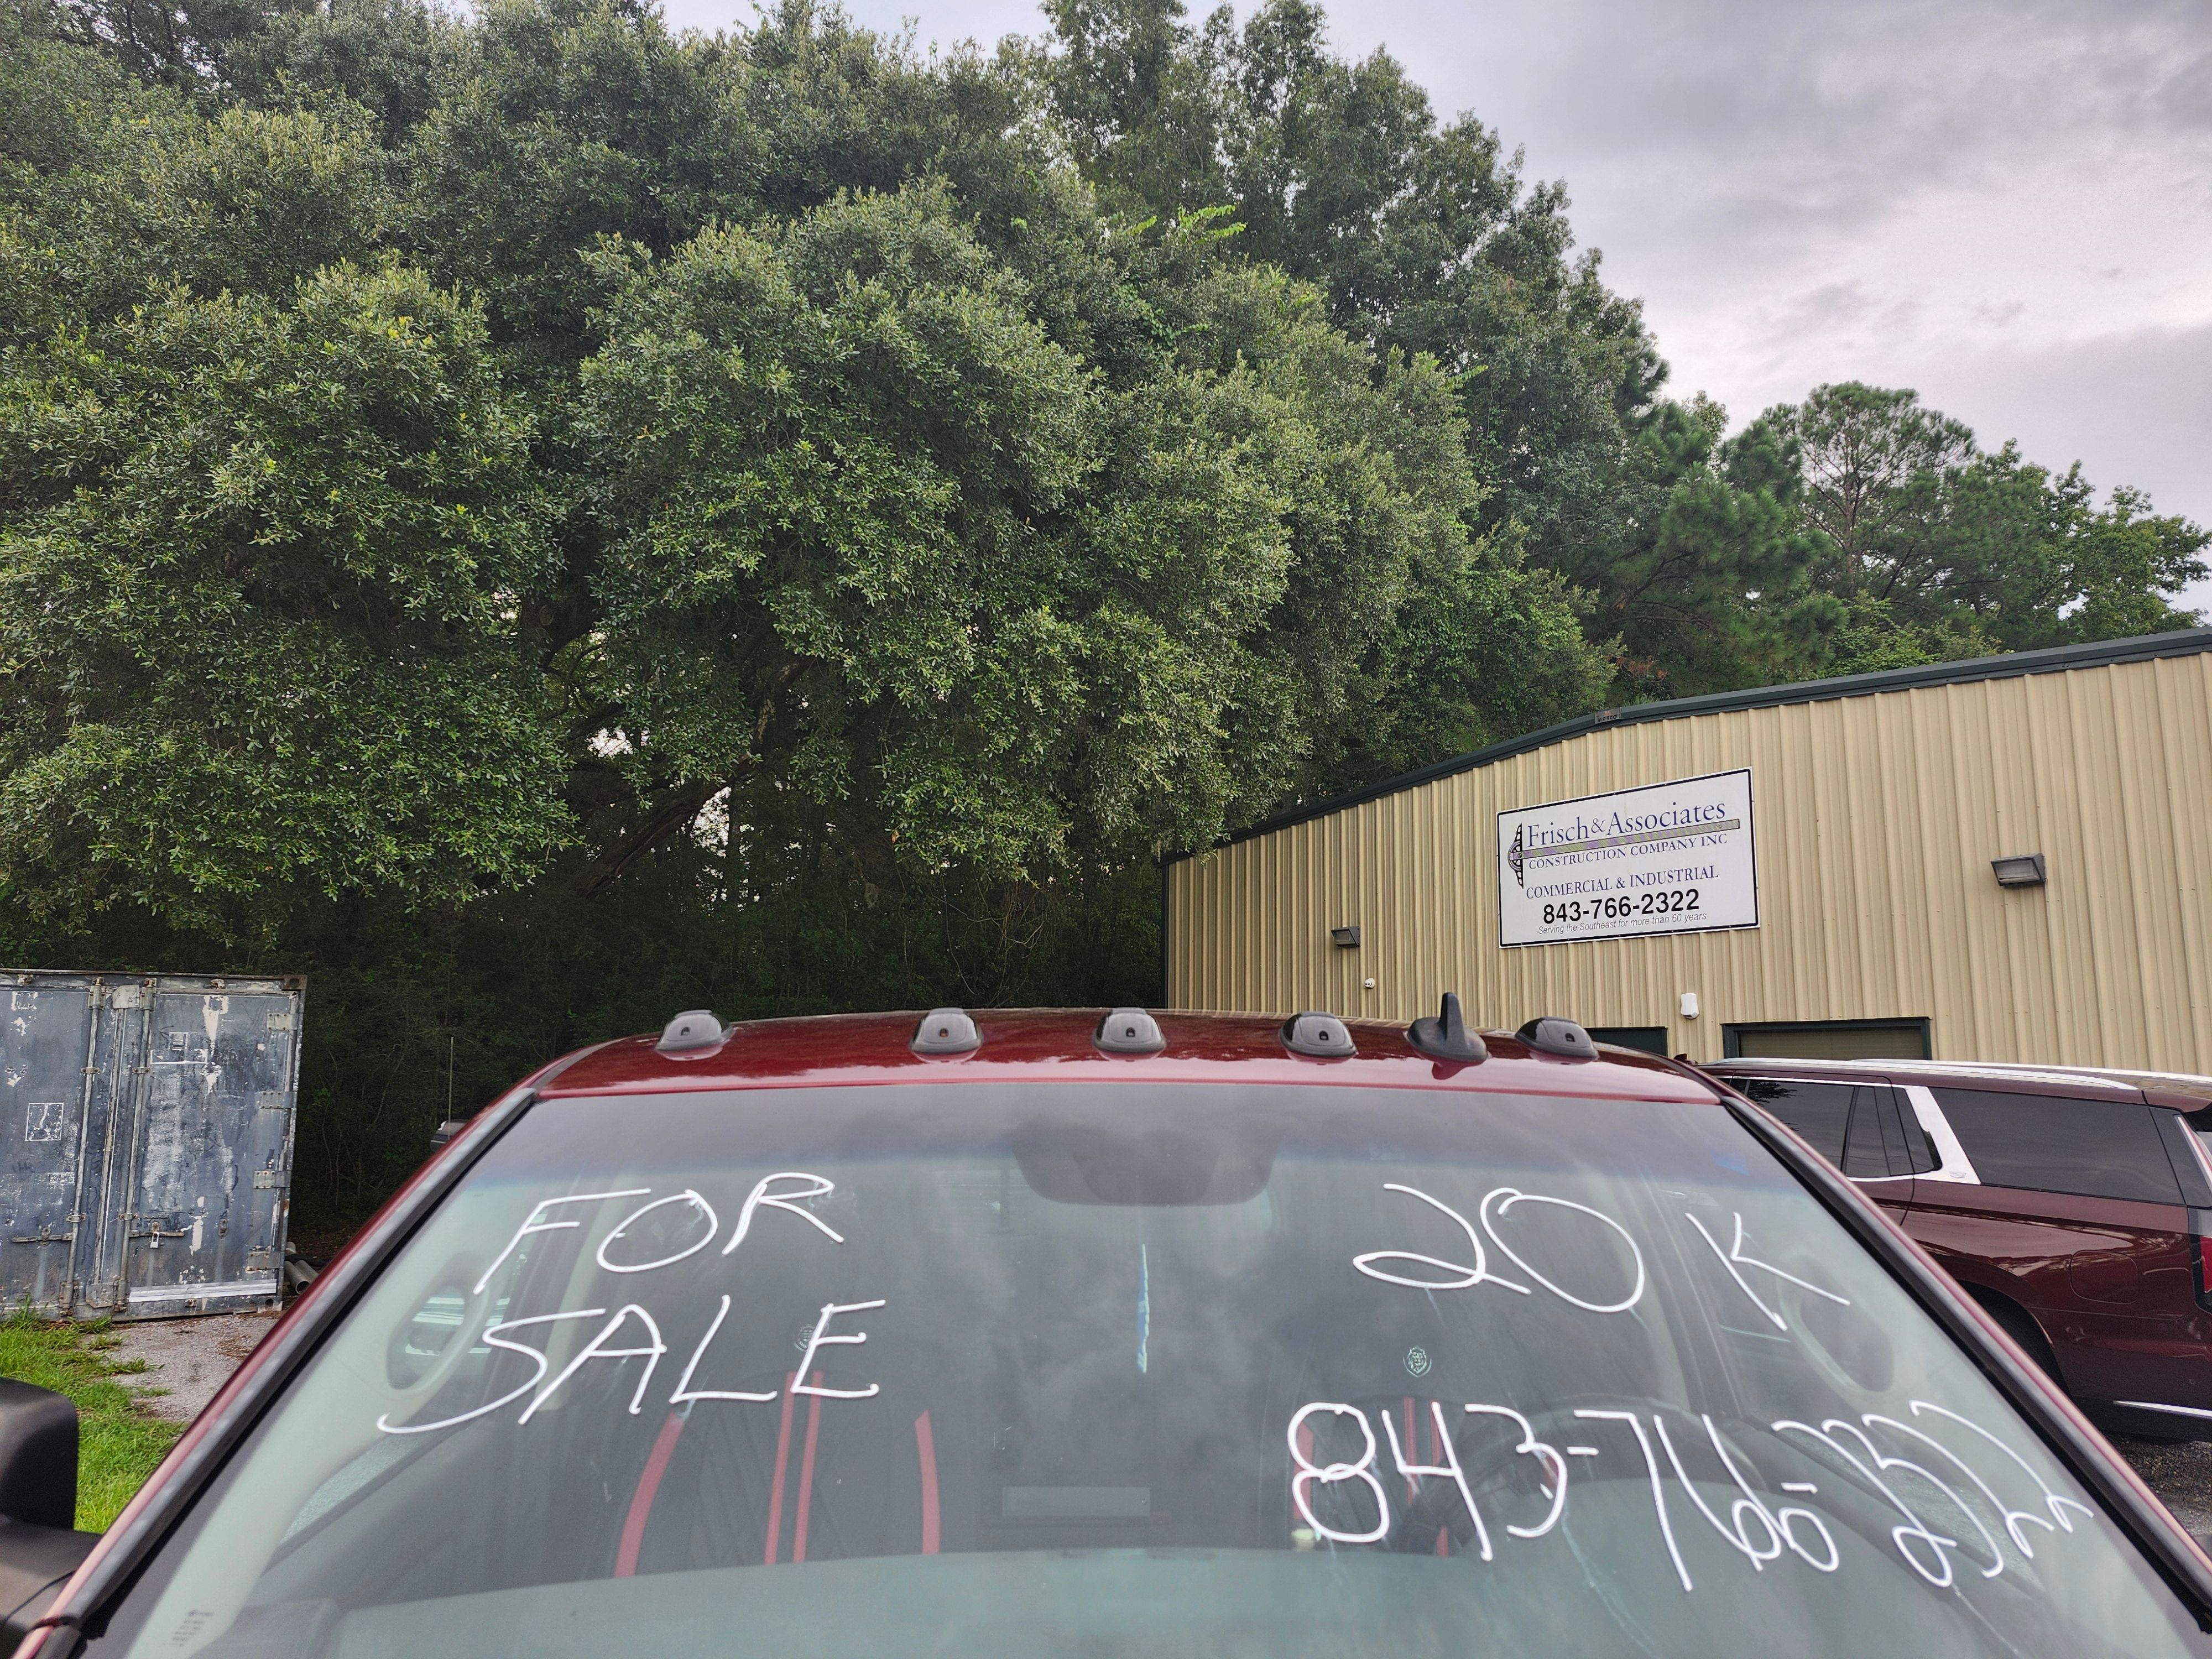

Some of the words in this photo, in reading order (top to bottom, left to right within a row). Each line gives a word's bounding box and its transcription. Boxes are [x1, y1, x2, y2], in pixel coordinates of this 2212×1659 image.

[1528, 847, 1627, 870] CONSTRUCTION
[1630, 837, 1698, 857] COMPANY
[1700, 833, 1728, 847] INC
[1526, 878, 1613, 900] COMMERCIAL
[1616, 877, 1626, 889] &
[1630, 865, 1719, 888] INDUSTRIAL
[1538, 926, 1564, 935] Serving
[1566, 924, 1578, 932] the
[1579, 920, 1617, 931] Southeast
[1618, 919, 1628, 927] for
[1630, 918, 1650, 926] more
[1652, 915, 1670, 924] than
[1672, 913, 1682, 922] 60
[1684, 913, 1707, 925] years
[1543, 888, 1700, 925] 843-766-2322
[473, 1172, 844, 1295] FOR
[377, 1295, 886, 1434] SALE
